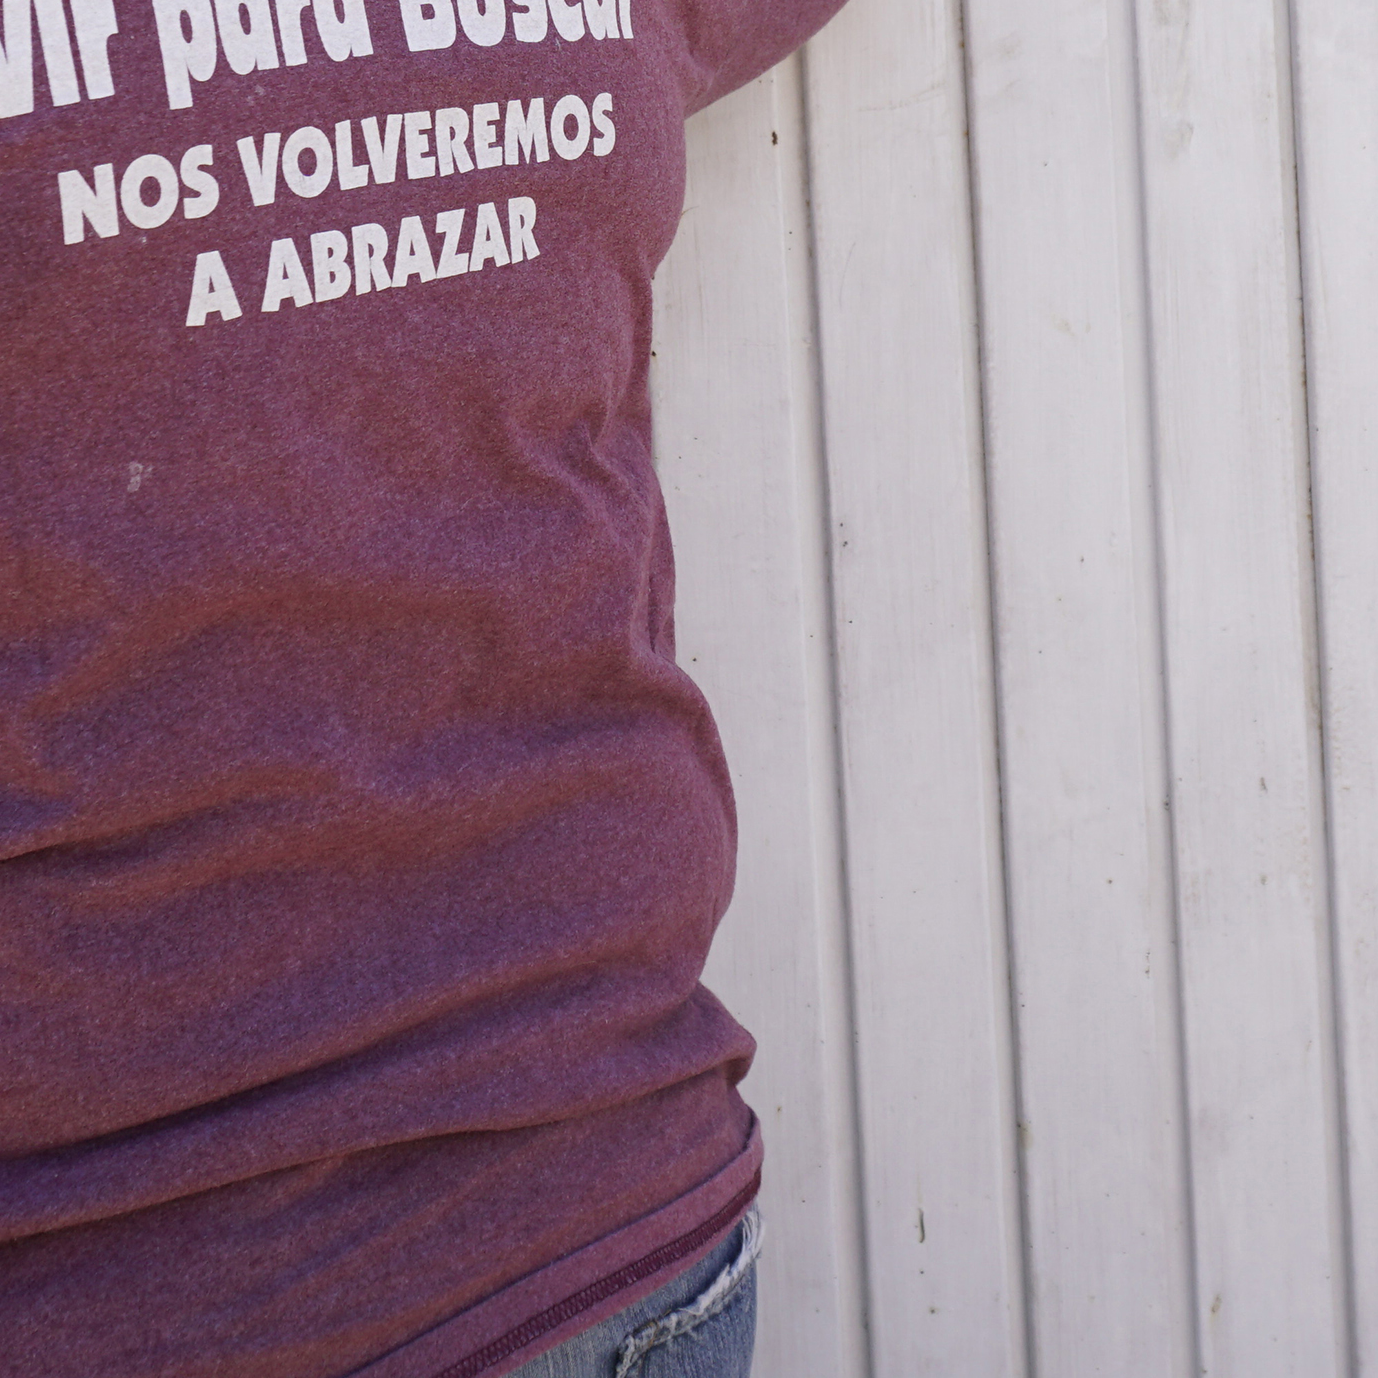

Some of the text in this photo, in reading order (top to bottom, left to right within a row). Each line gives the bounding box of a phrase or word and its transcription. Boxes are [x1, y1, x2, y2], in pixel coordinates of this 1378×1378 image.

[56, 92, 617, 245] NOS VOLVEREMOS
[184, 195, 539, 327] A ABRAZAR
